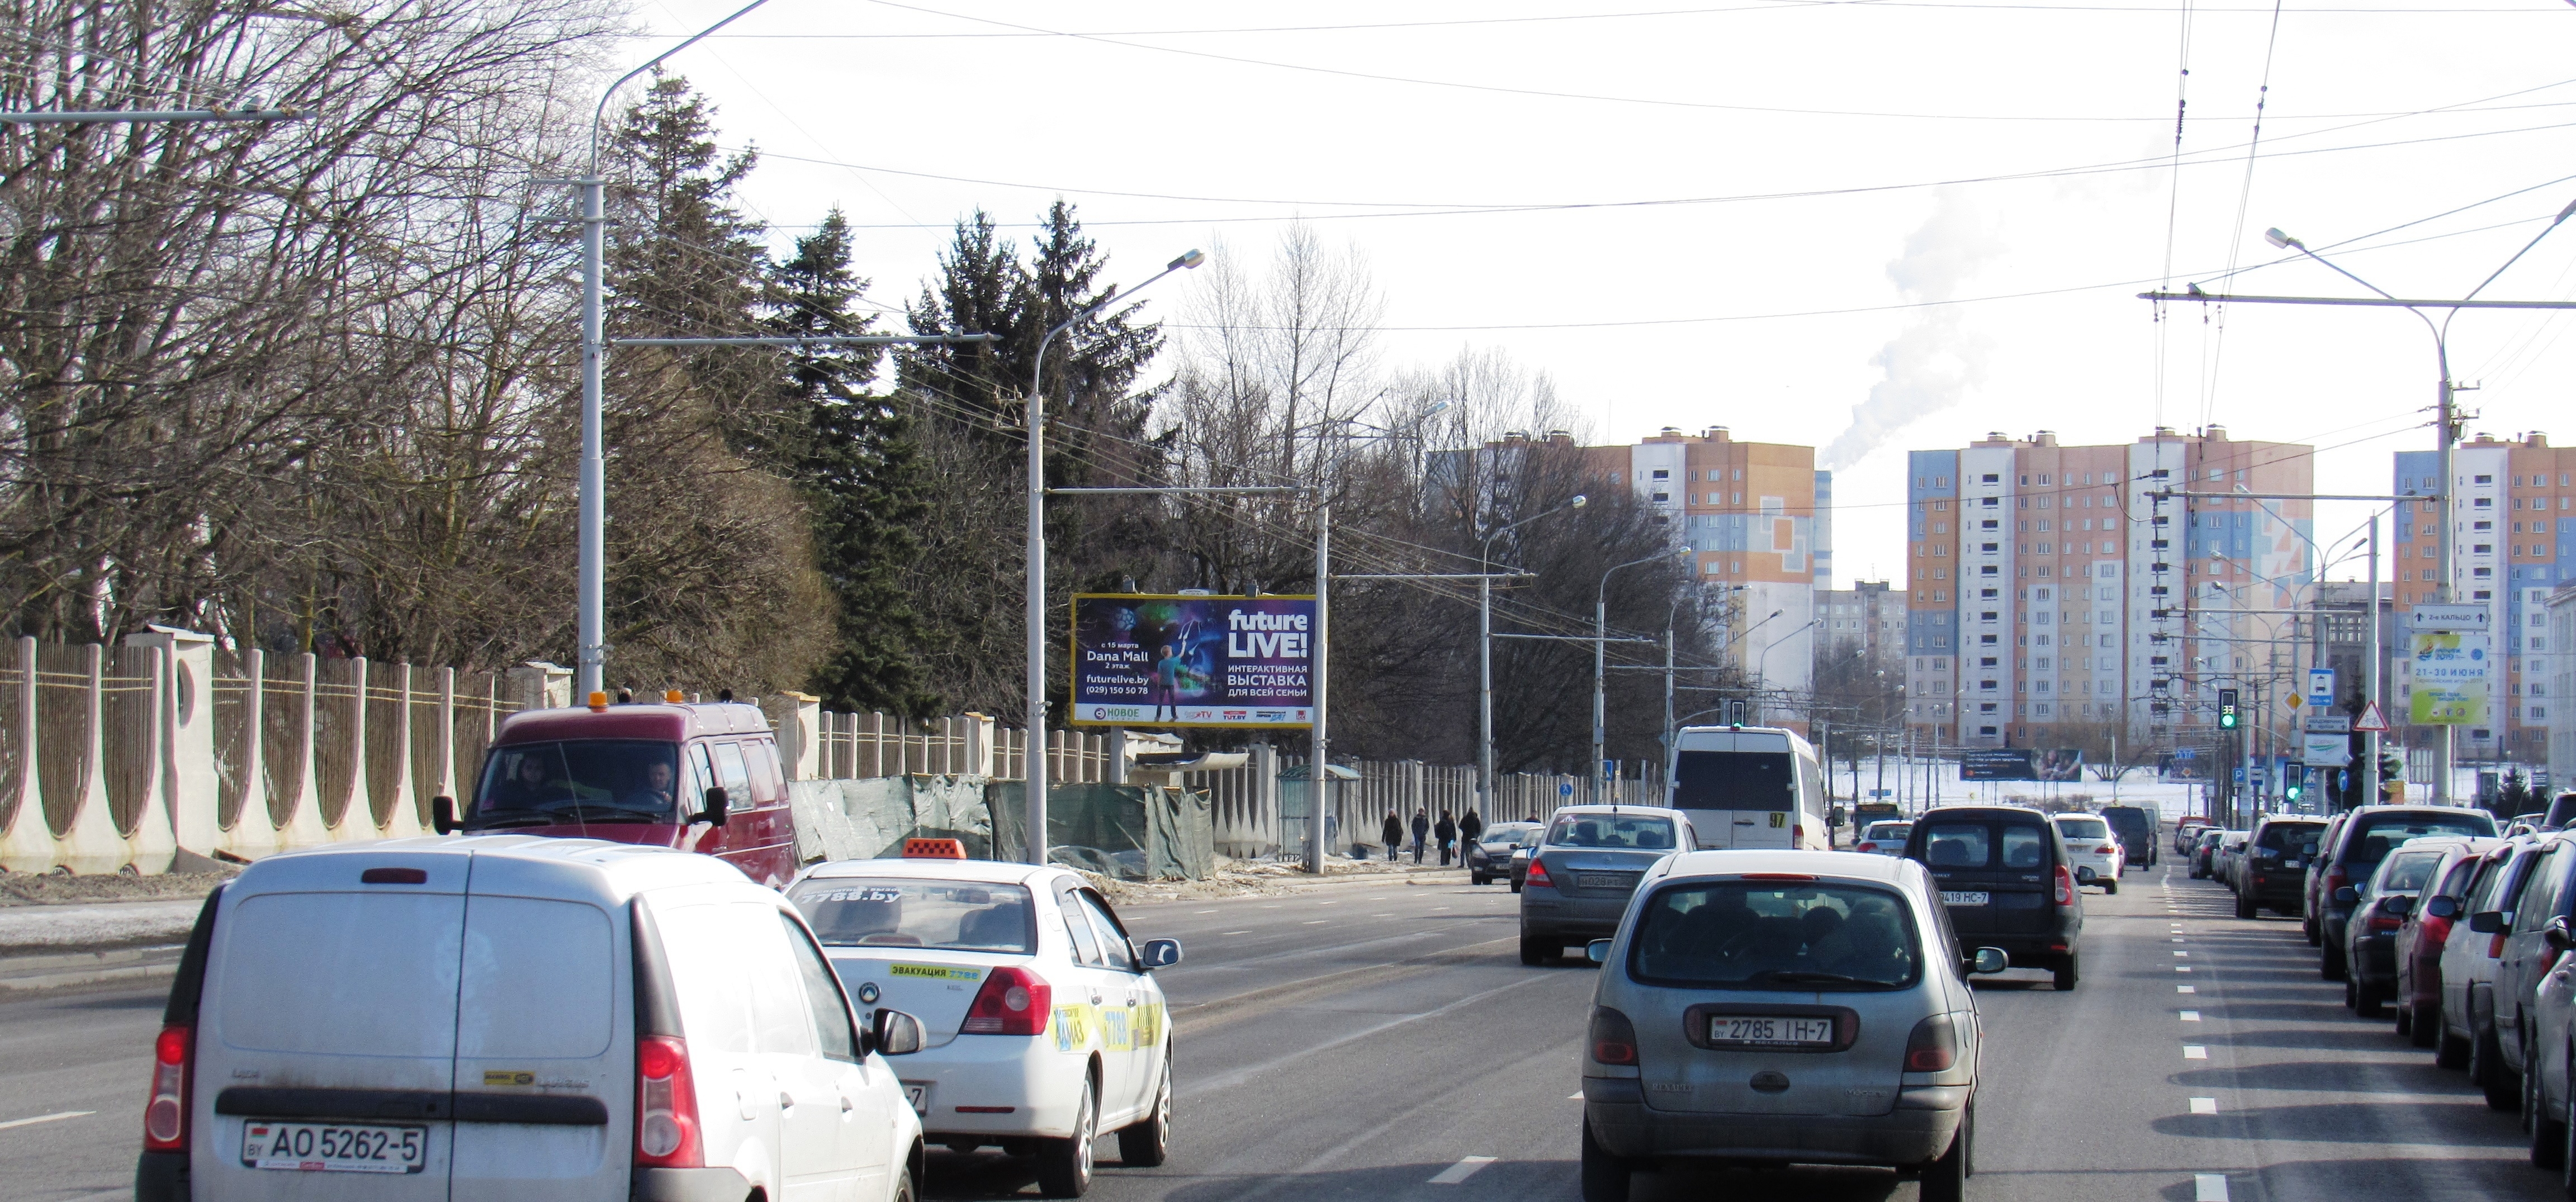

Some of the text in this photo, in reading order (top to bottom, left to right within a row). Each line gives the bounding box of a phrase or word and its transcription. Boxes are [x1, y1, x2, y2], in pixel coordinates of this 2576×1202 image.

[1228, 609, 1308, 631] future
[1228, 632, 1308, 658] LIVE!
[1087, 650, 1149, 662] Dana Mall
[1228, 665, 1308, 673] ИНТЕРАКТИВНАЯ
[1086, 674, 1149, 686] futurelive.by
[1227, 674, 1307, 686] ВЫСТАВКА
[1086, 686, 1108, 695] (029)
[1138, 686, 1149, 695] 78
[1228, 687, 1307, 697] ДЛЯ ВСЕЙ СЕМЬИ
[1107, 708, 1140, 718] НОВОЕ
[1769, 813, 1785, 828] 97
[801, 891, 902, 904] 7788.by
[892, 966, 979, 980] ЭВАКУАЦИЯ 7788
[1730, 1020, 1774, 1039] 2785
[247, 1144, 263, 1156] BY
[271, 1127, 419, 1161] AO 5262-5
